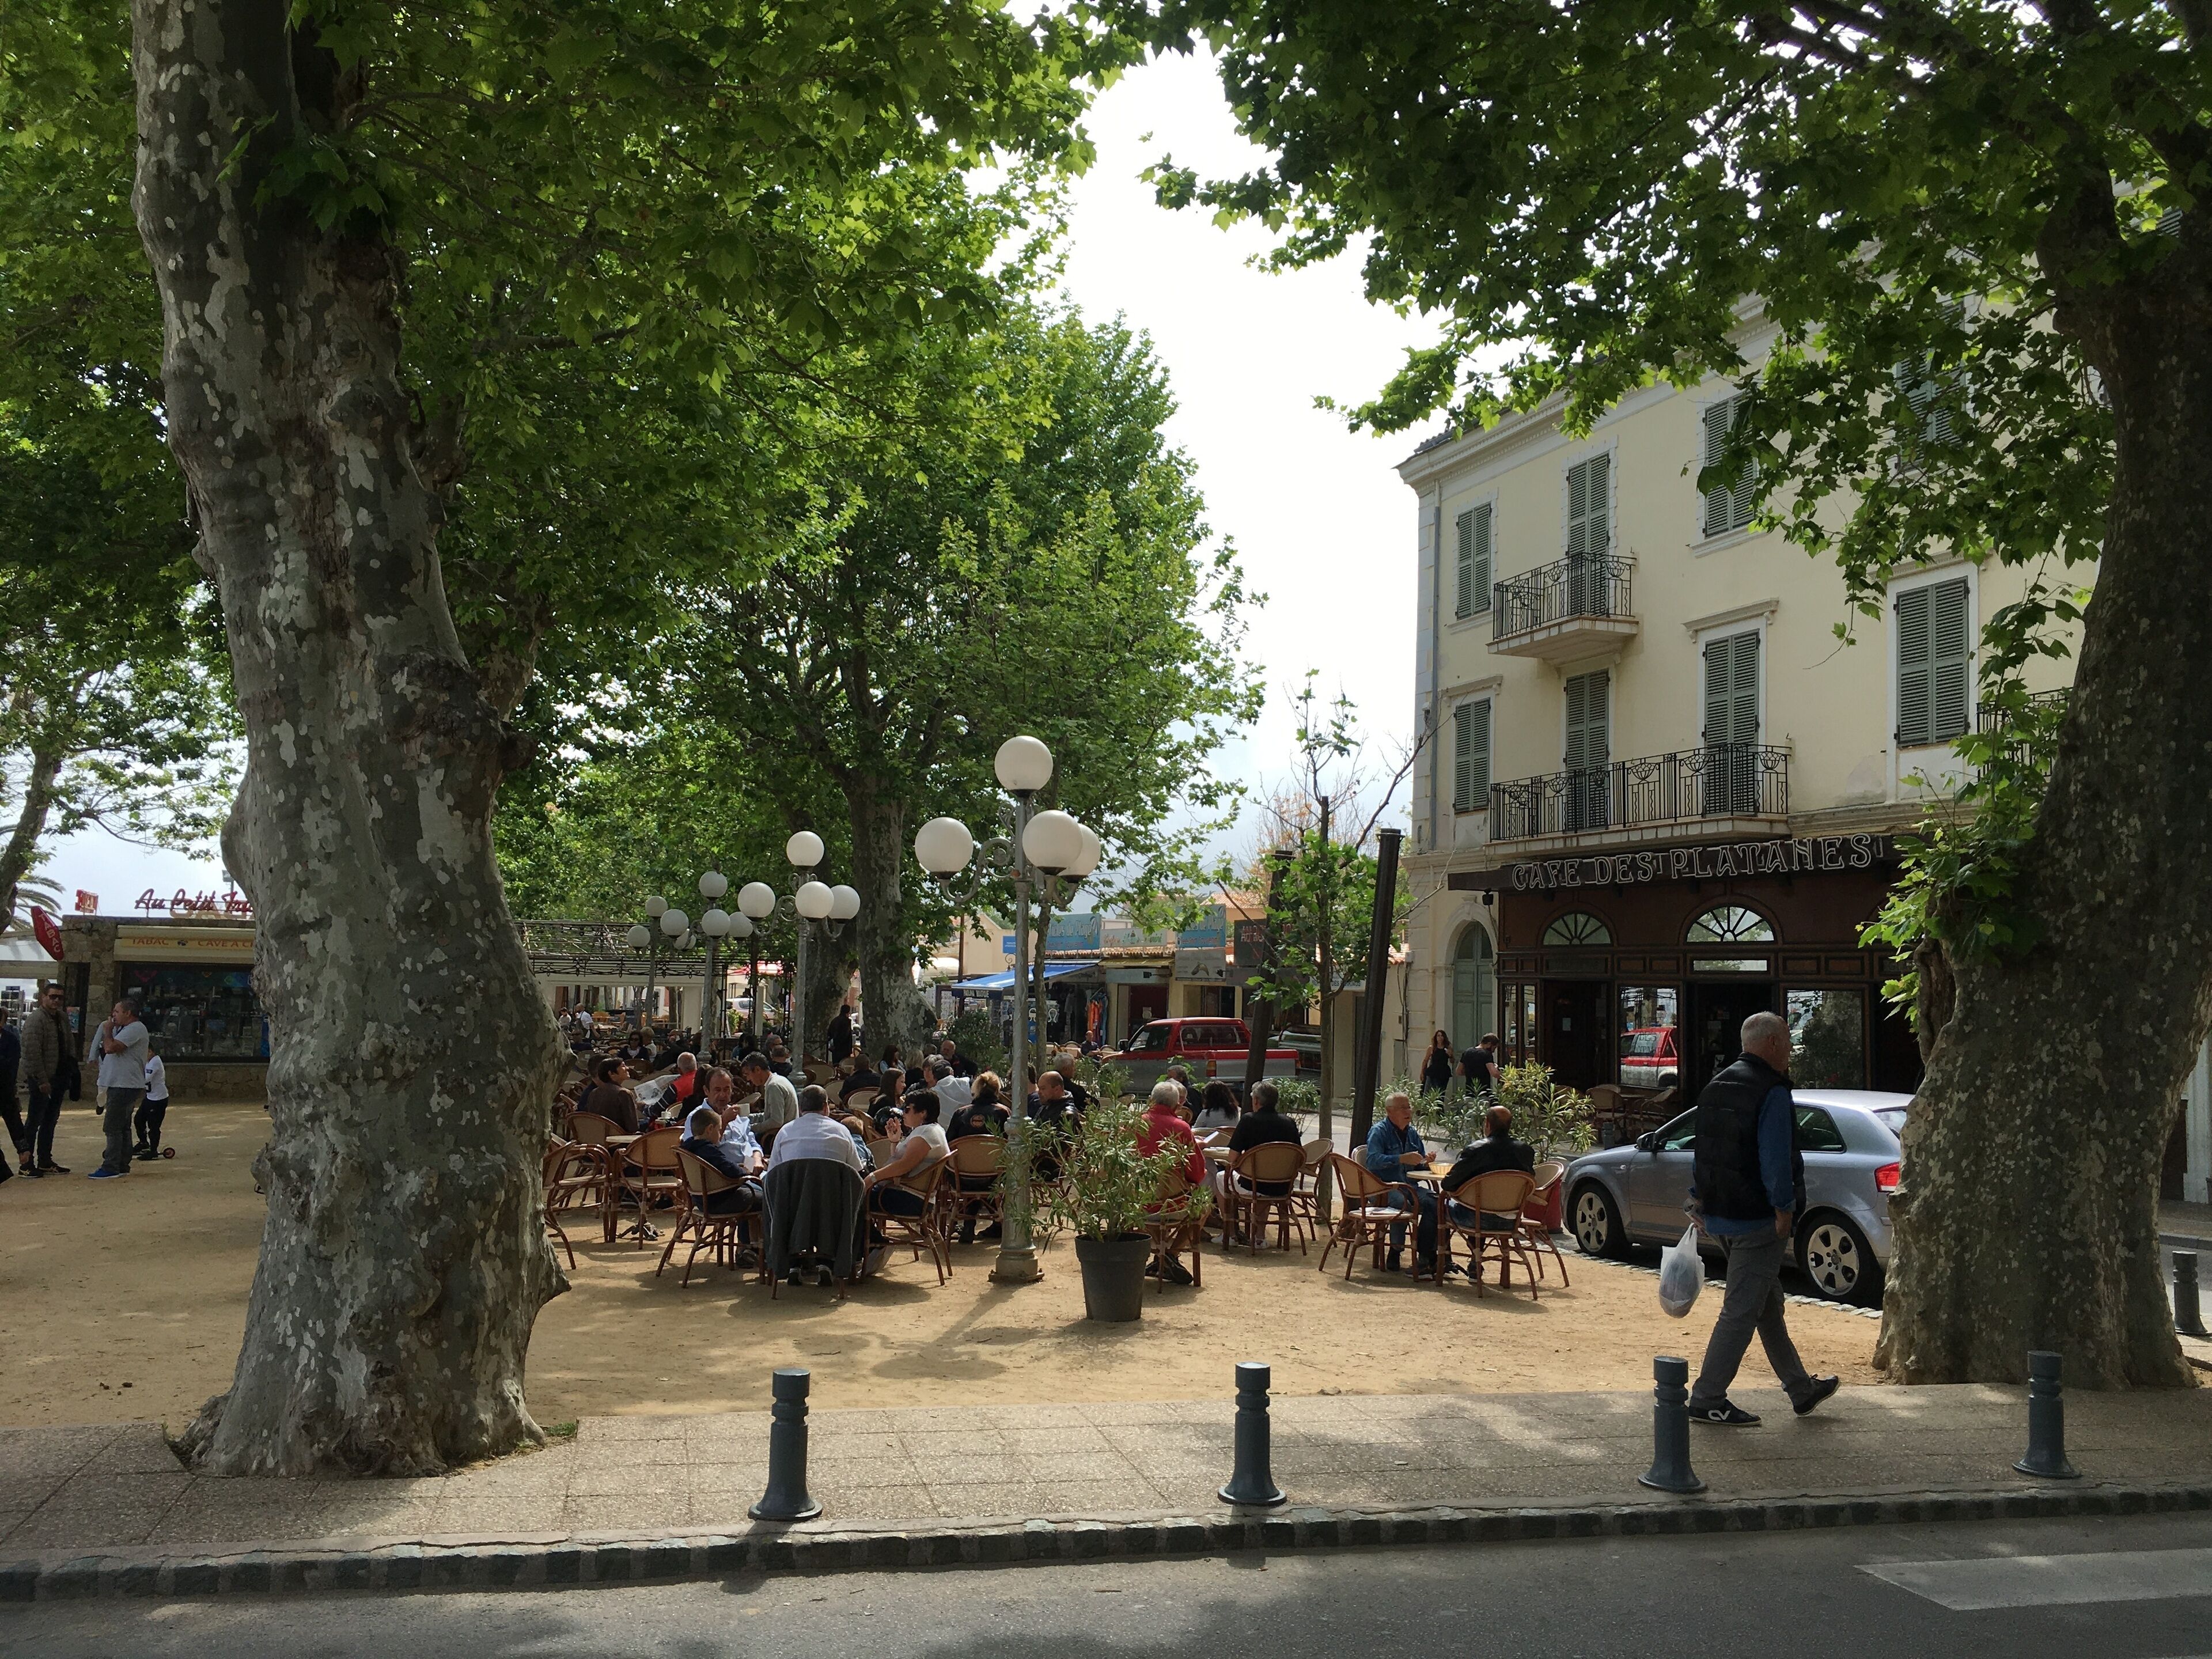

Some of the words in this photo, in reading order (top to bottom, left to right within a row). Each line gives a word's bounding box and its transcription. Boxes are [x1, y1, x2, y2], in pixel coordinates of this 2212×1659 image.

[1512, 858, 1581, 891] CAFE
[1594, 851, 1653, 884] DES
[1670, 833, 1872, 879] PLATANES
[134, 888, 165, 909] Au
[170, 888, 216, 911] Petit
[39, 914, 60, 953] TABAC
